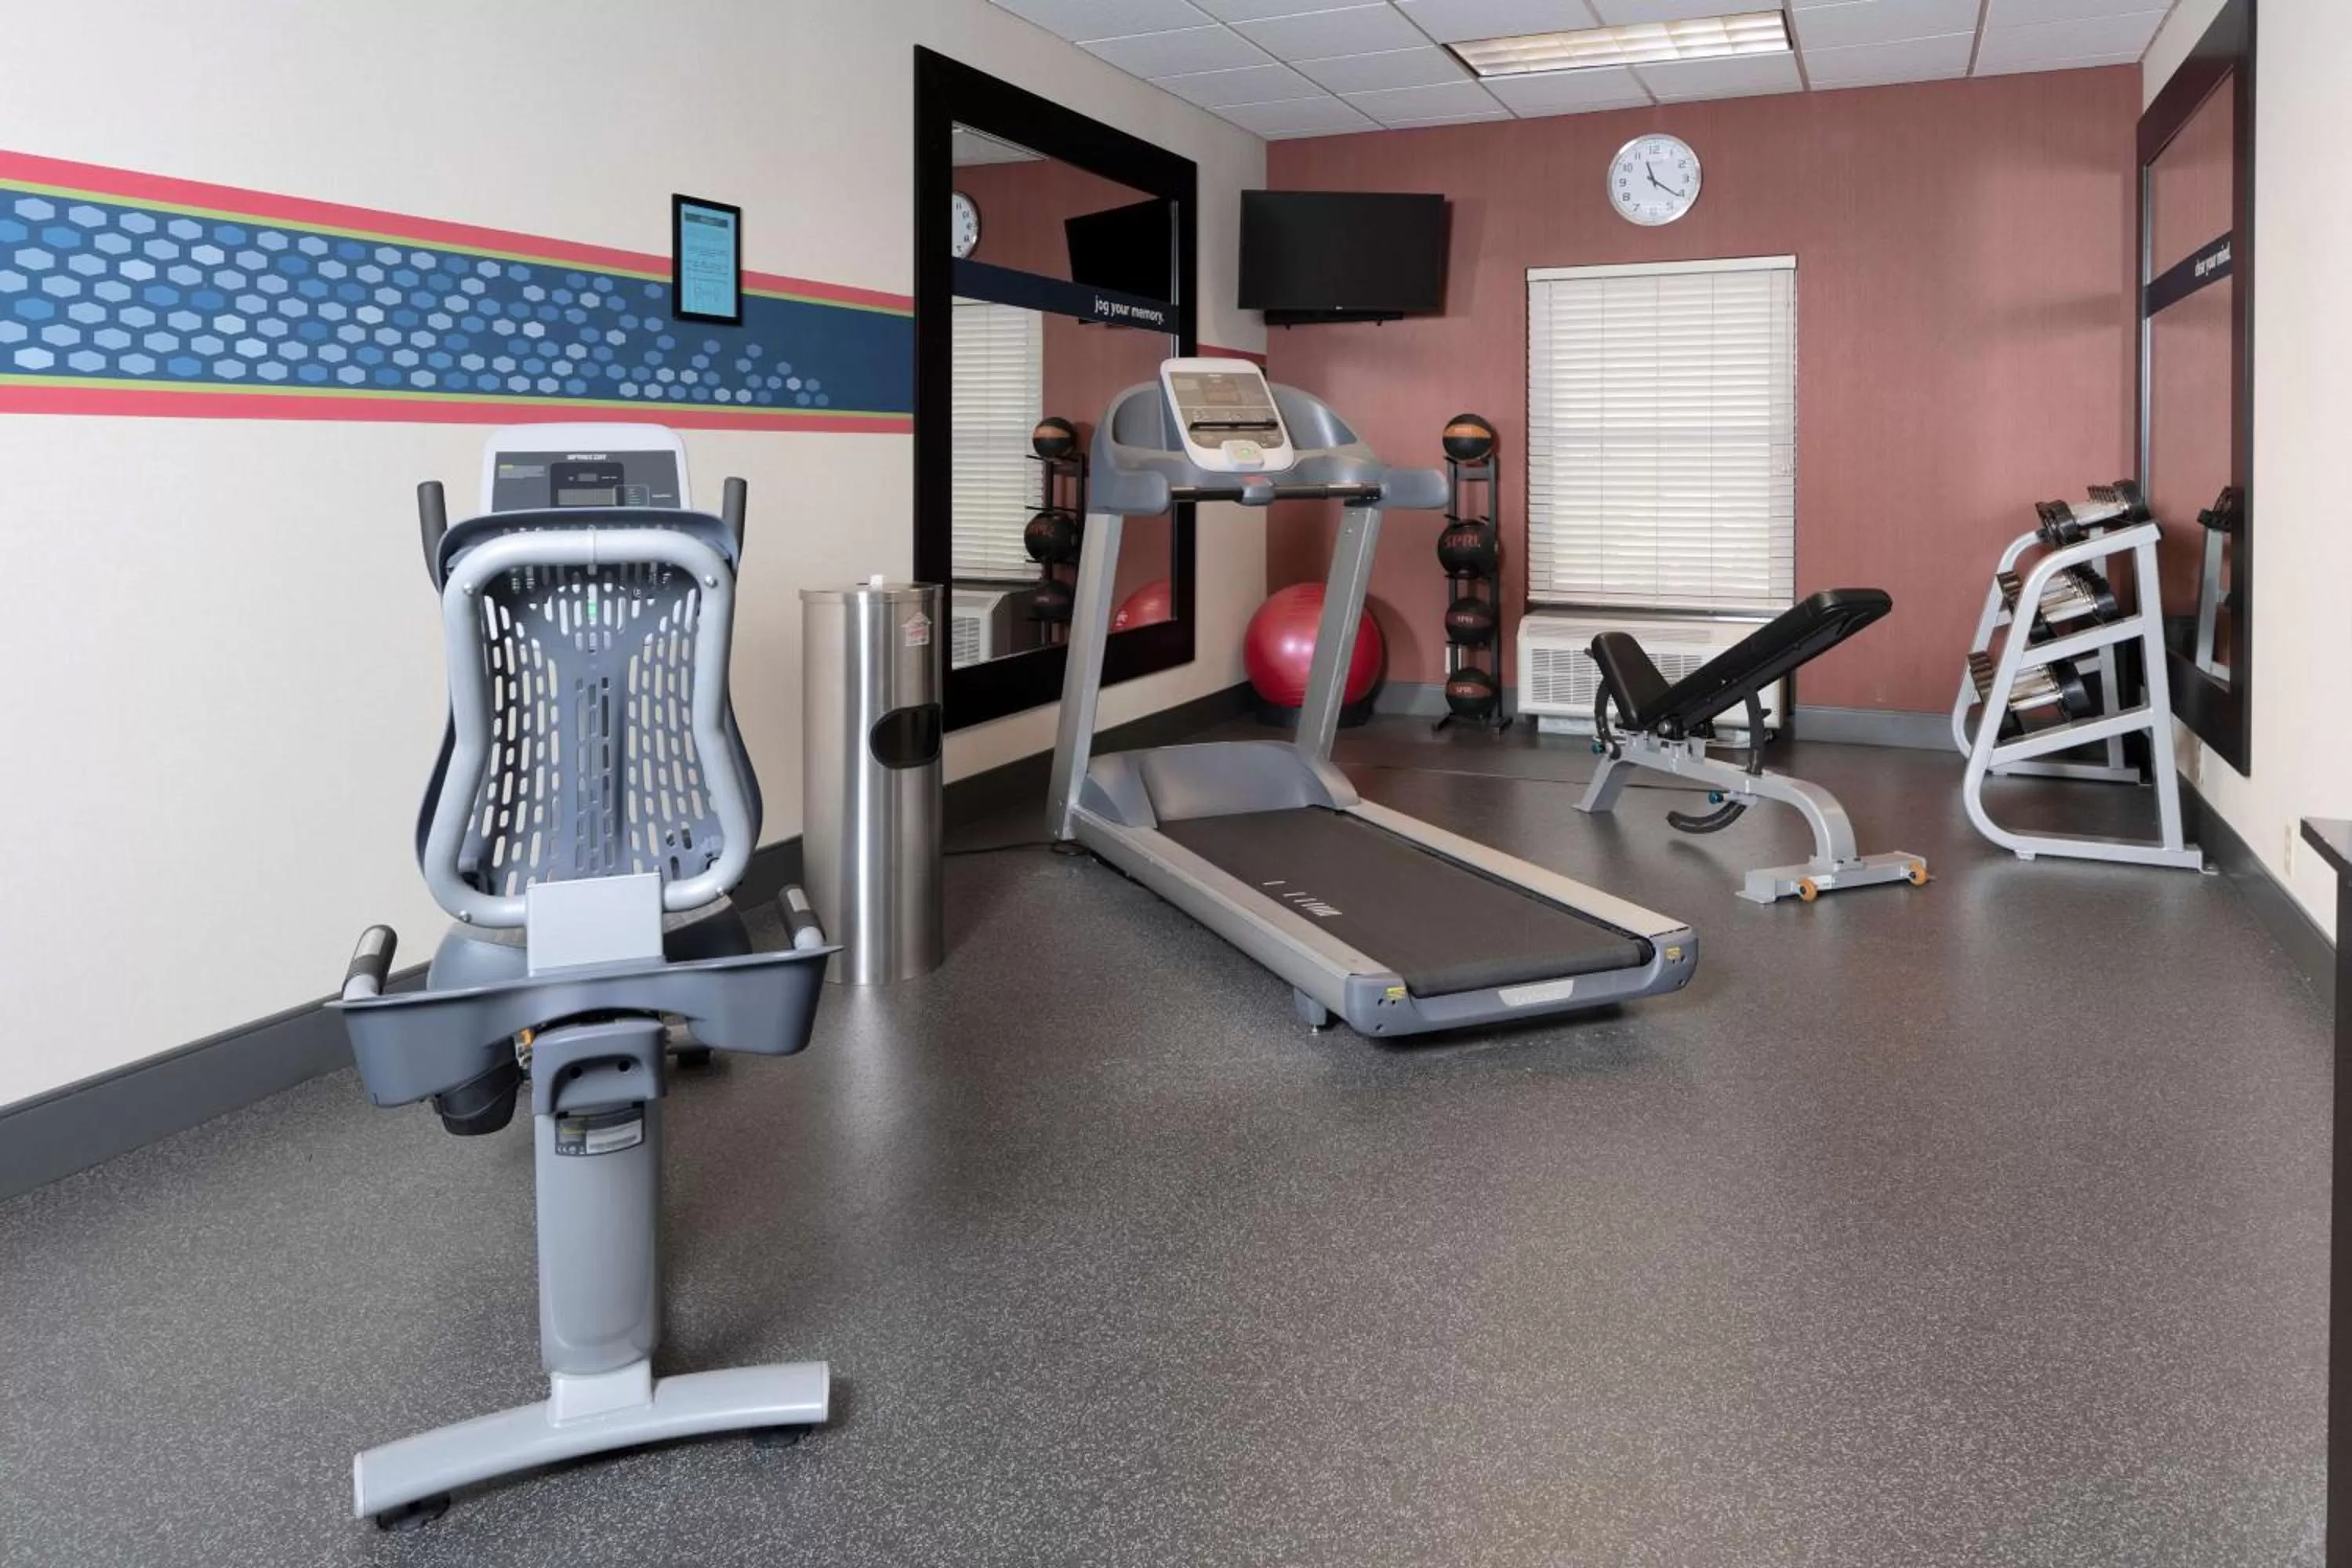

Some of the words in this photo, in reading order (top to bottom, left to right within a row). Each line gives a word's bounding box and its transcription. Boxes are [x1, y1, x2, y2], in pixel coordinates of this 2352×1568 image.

[1648, 145, 1661, 154] 12
[1635, 152, 1641, 160] 11
[1623, 163, 1633, 173] 10
[1678, 160, 1686, 169] 2
[1619, 178, 1627, 187] 9
[1622, 193, 1631, 201] 8
[1633, 203, 1641, 212] 7
[1094, 294, 1109, 315] jog
[1110, 302, 1129, 317] your
[1131, 307, 1165, 325] memory.
